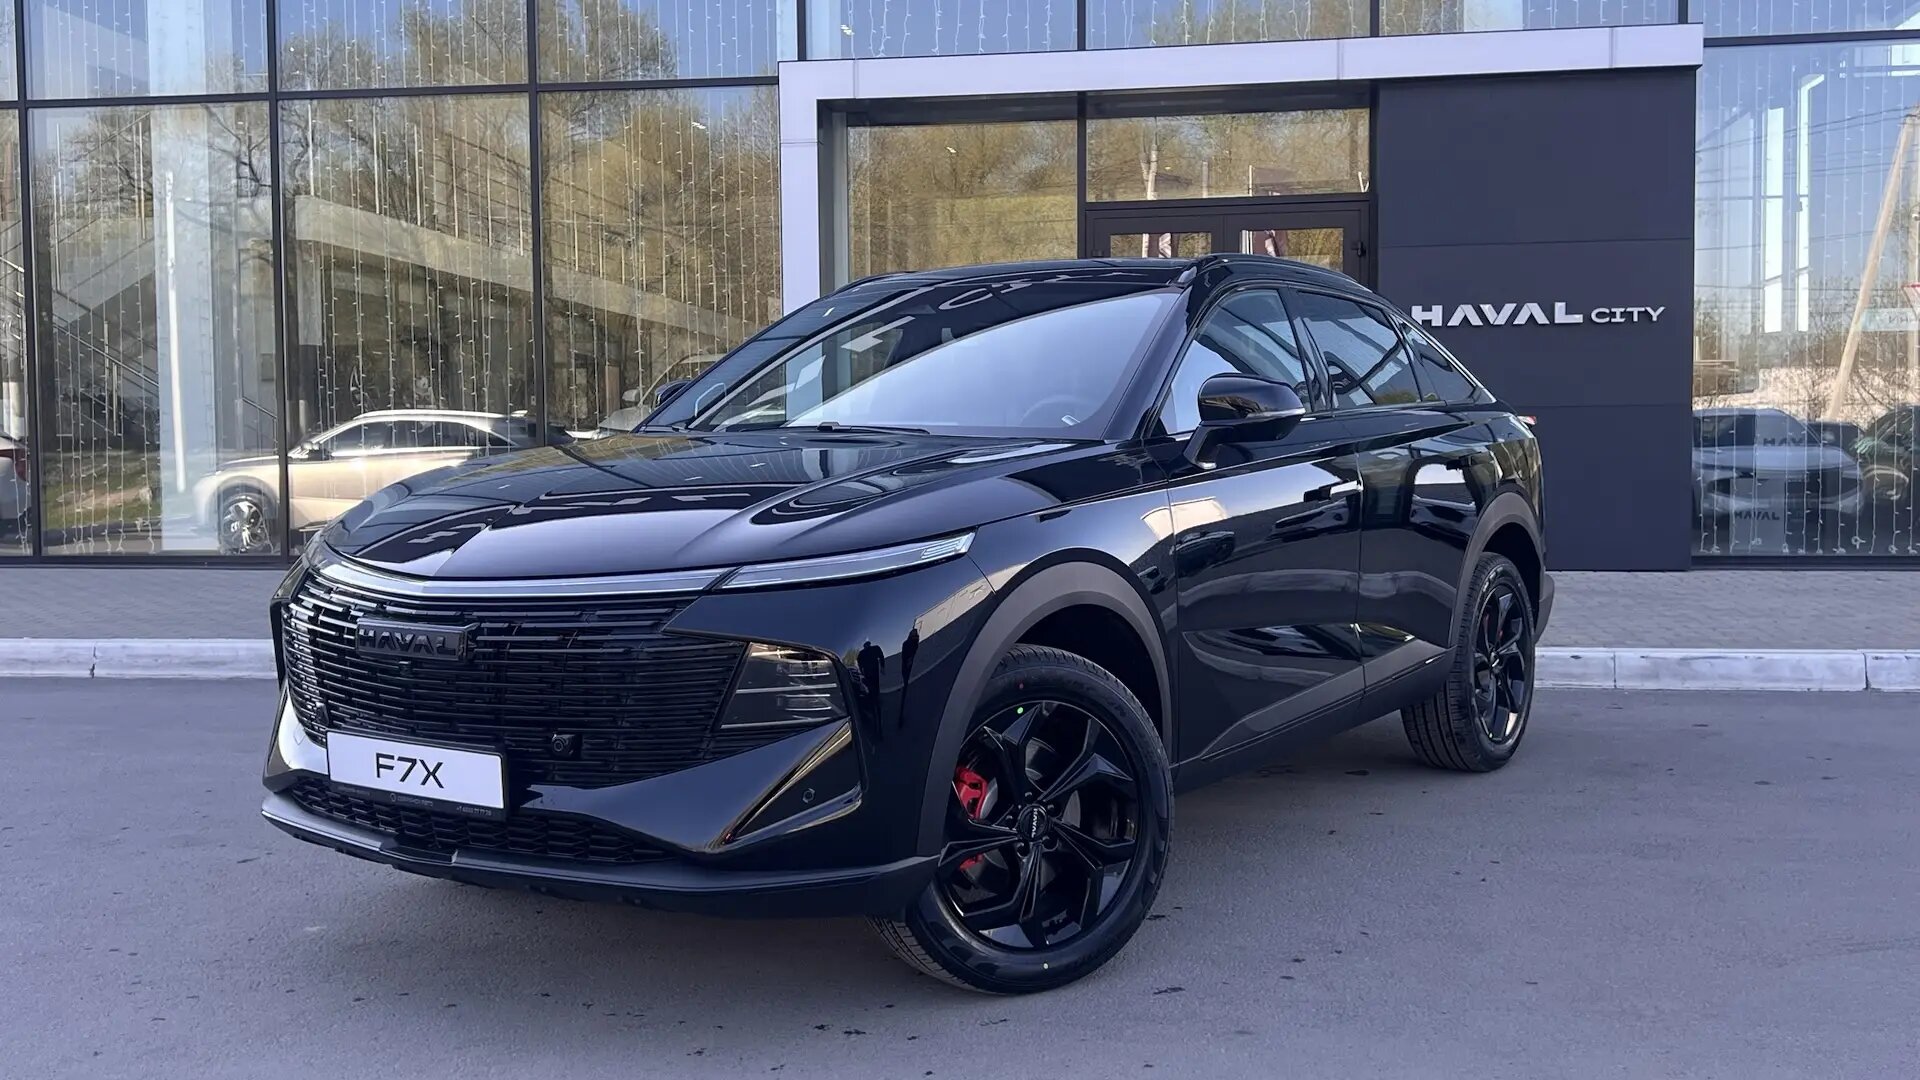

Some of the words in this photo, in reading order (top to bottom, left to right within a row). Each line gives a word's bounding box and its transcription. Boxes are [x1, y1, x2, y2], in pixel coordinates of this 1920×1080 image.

[1411, 302, 1583, 326] HAVAL
[1591, 306, 1666, 323] CITY
[358, 628, 456, 654] HAVAL
[375, 752, 445, 789] F7X
